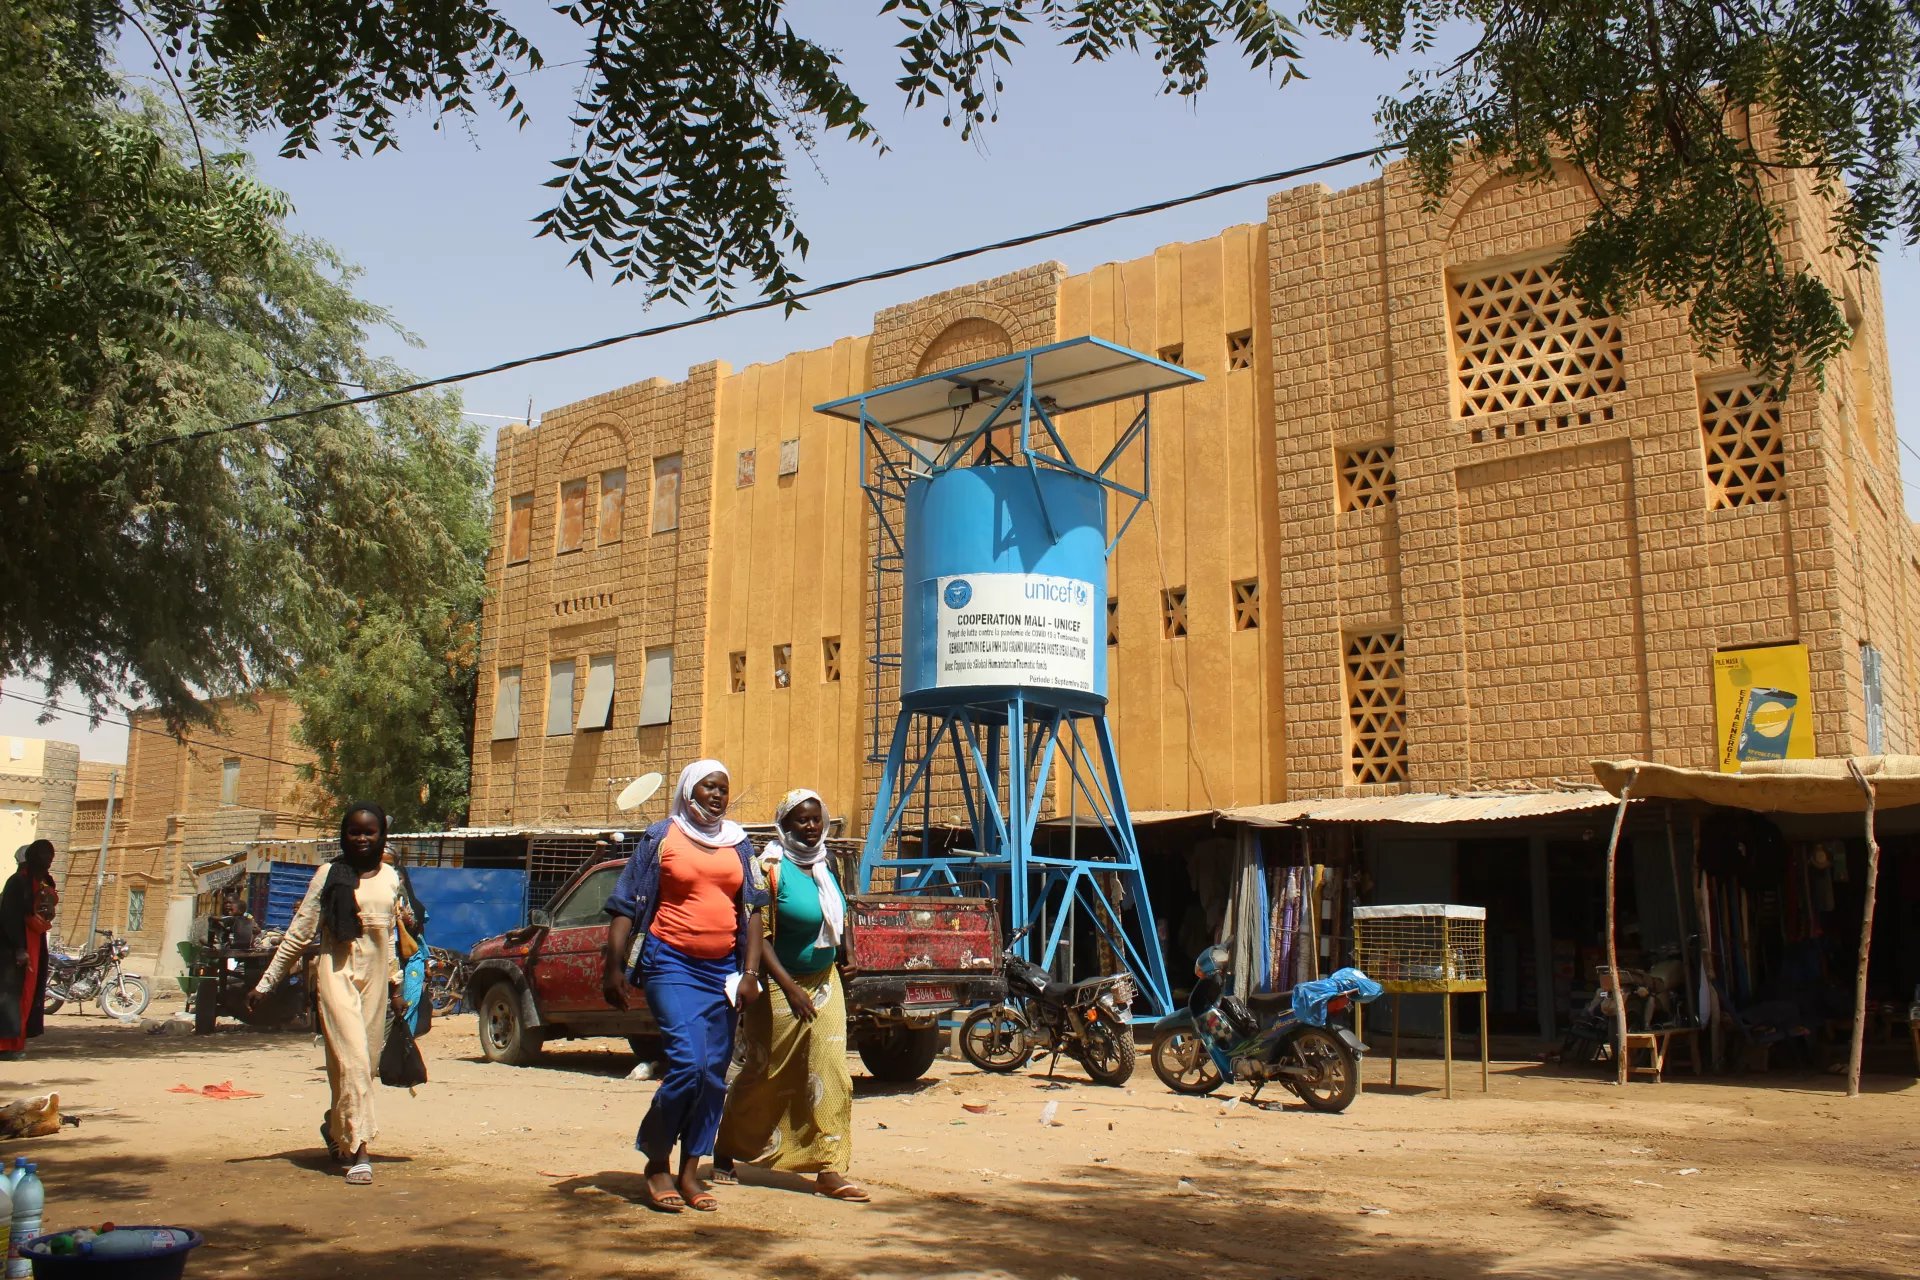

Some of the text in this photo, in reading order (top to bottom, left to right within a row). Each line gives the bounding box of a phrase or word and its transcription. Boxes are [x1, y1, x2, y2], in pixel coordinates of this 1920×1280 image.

[1025, 578, 1073, 603] unicef
[957, 613, 1021, 626] COOPERATION
[1024, 614, 1046, 628] MALI
[1054, 618, 1081, 632] UNICEF
[947, 629, 960, 640] Projet
[960, 628, 966, 637] de
[966, 629, 978, 637] lutte
[979, 629, 994, 637] contre
[995, 628, 1000, 636] la
[1025, 629, 1031, 637] de
[1032, 630, 1047, 638] COVID
[980, 641, 986, 653] DE
[986, 641, 992, 653] LA
[1002, 641, 1009, 652] DU
[1041, 642, 1047, 654] EN
[1047, 643, 1059, 656] POSTE
[1054, 676, 1080, 688] Septembre
[1724, 689, 1747, 765] EXTRA ENERGIE
[858, 911, 906, 926] NISSN
